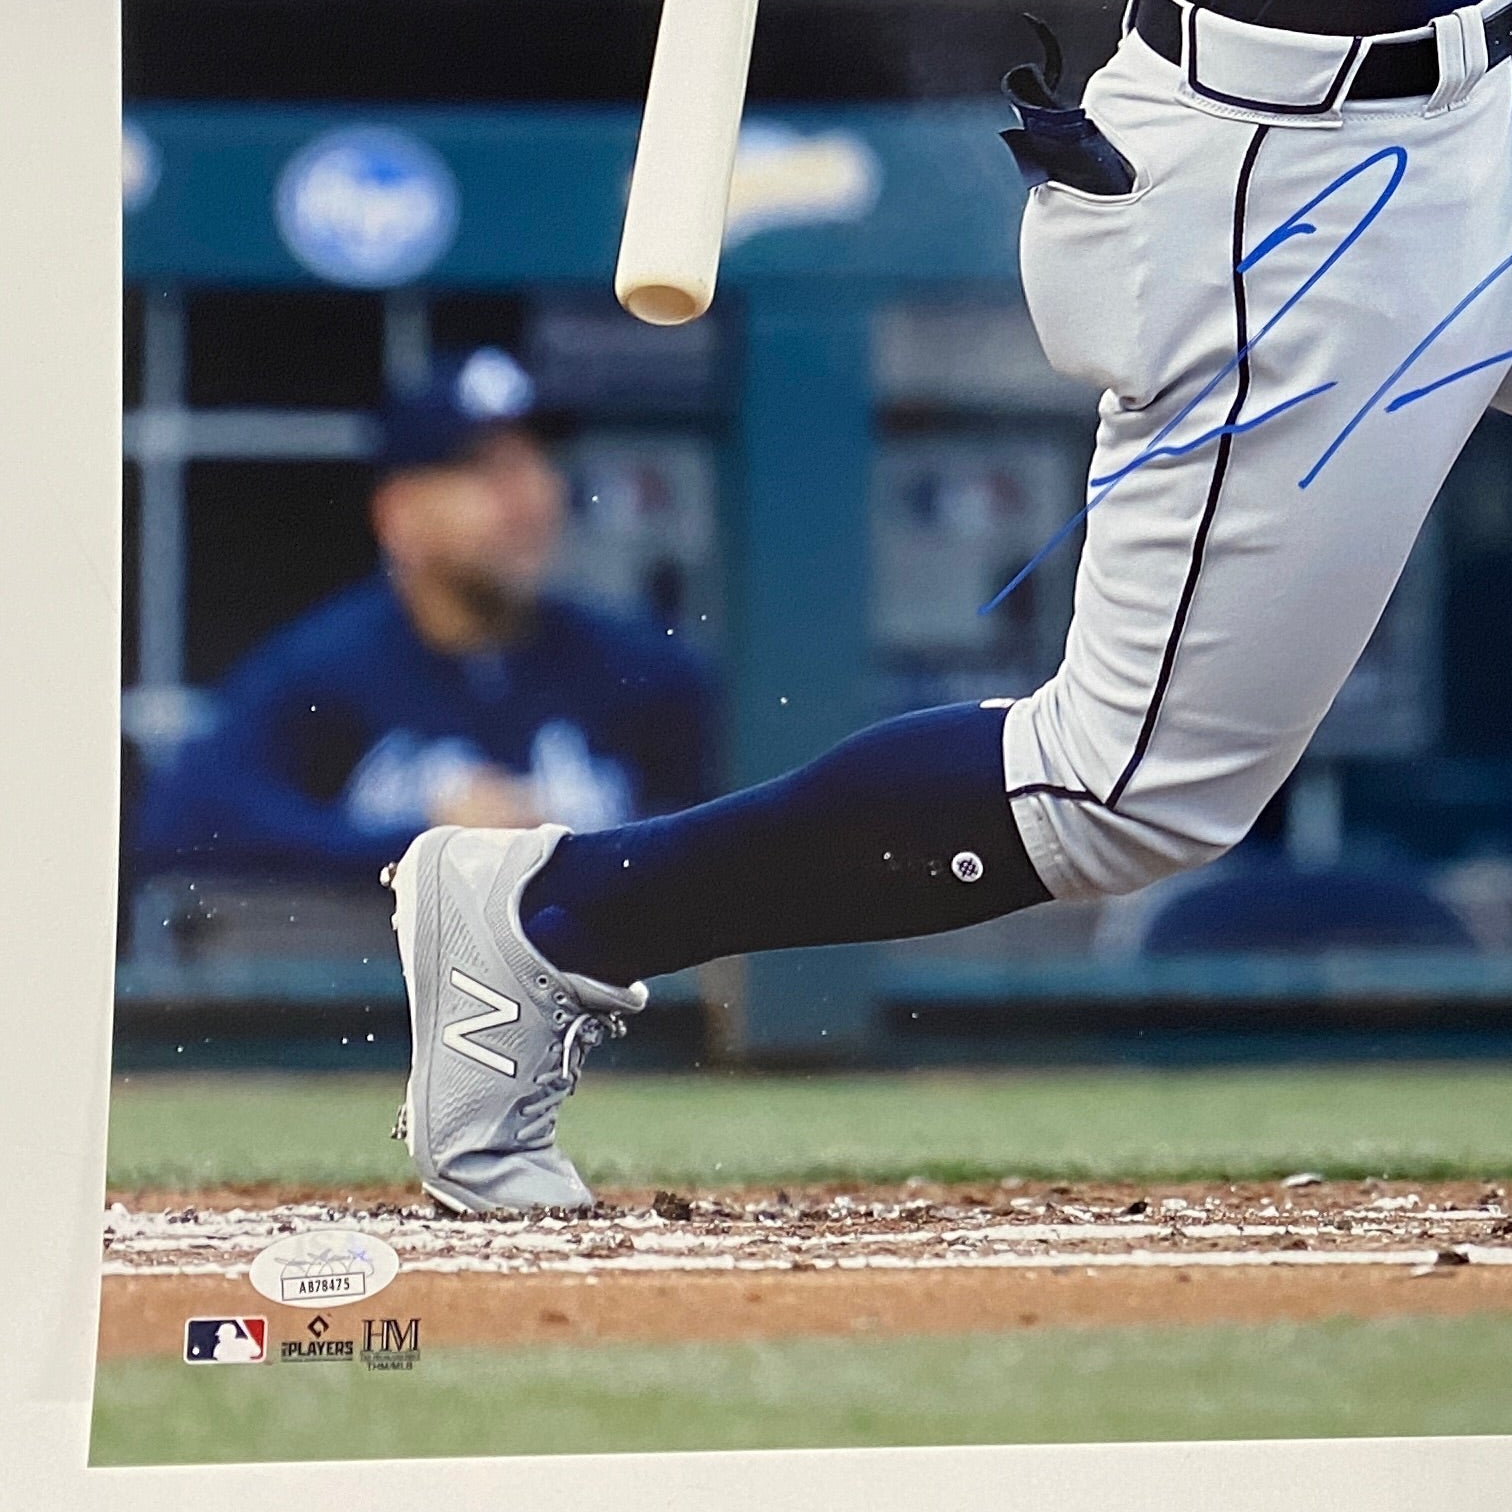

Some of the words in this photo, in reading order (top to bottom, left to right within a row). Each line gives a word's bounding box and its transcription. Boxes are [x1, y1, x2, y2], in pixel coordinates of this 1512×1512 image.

[299, 1277, 351, 1295] AB78475
[361, 1319, 421, 1352] HM
[288, 1340, 353, 1356] PLAYERS
